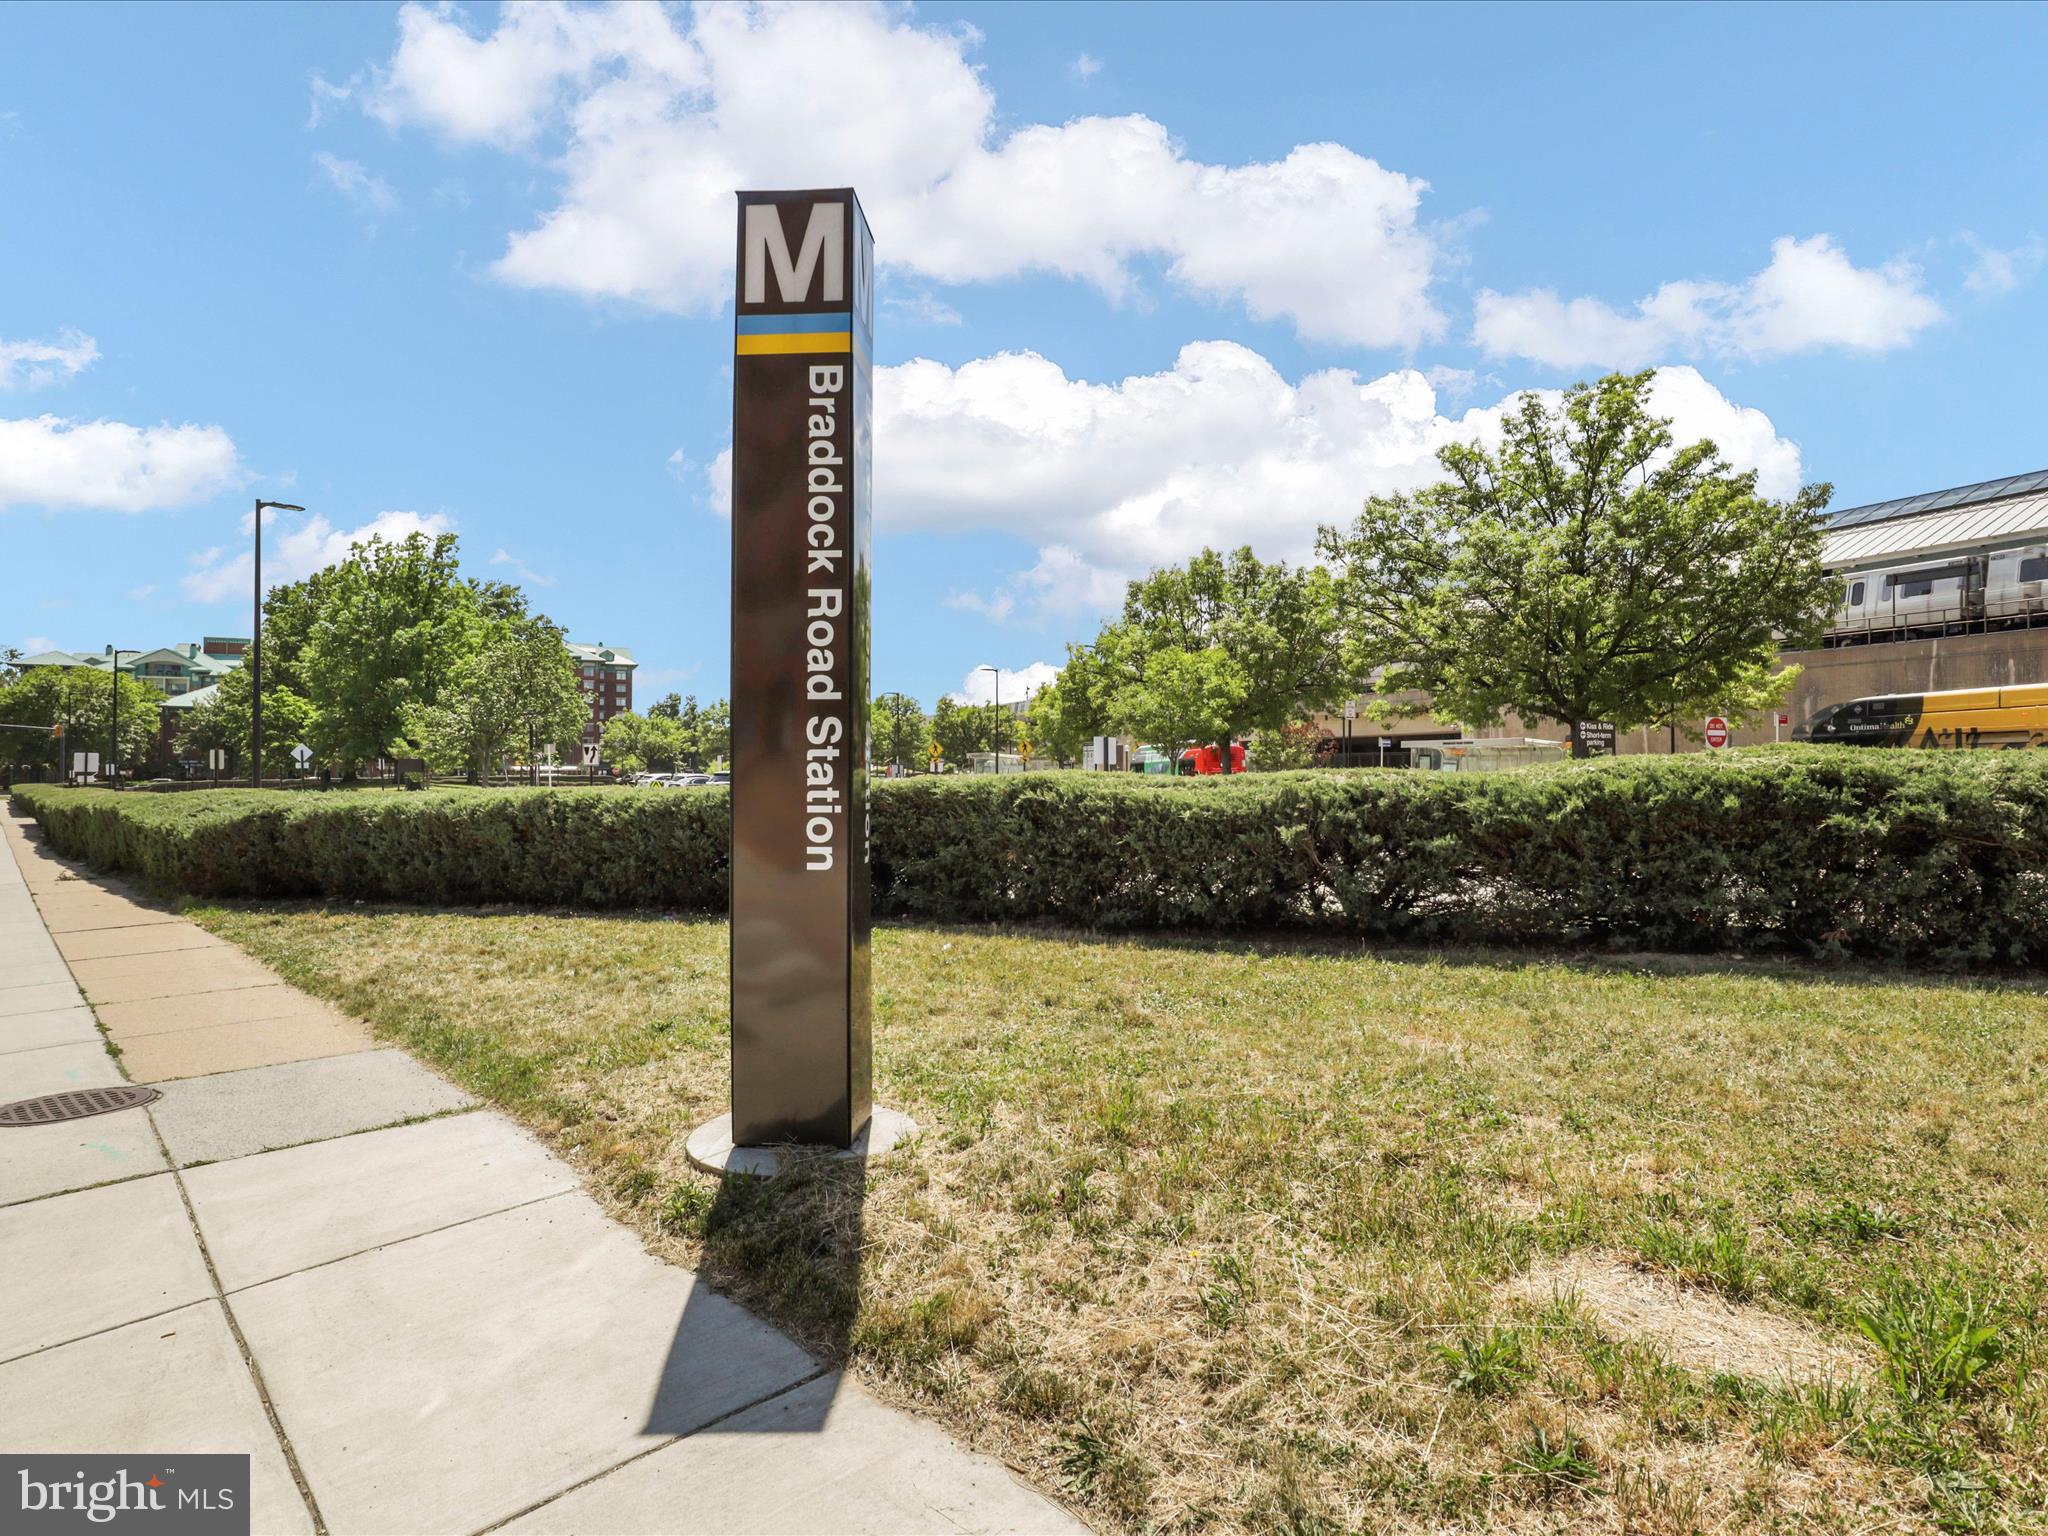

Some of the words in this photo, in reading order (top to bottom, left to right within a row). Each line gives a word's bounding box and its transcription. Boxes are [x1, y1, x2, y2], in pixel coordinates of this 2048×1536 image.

[744, 202, 844, 303] M
[808, 365, 843, 574] Braddock
[806, 588, 842, 700] Road
[1586, 731, 1612, 739] Short-term
[1586, 739, 1605, 747] parking
[806, 716, 842, 870] Station
